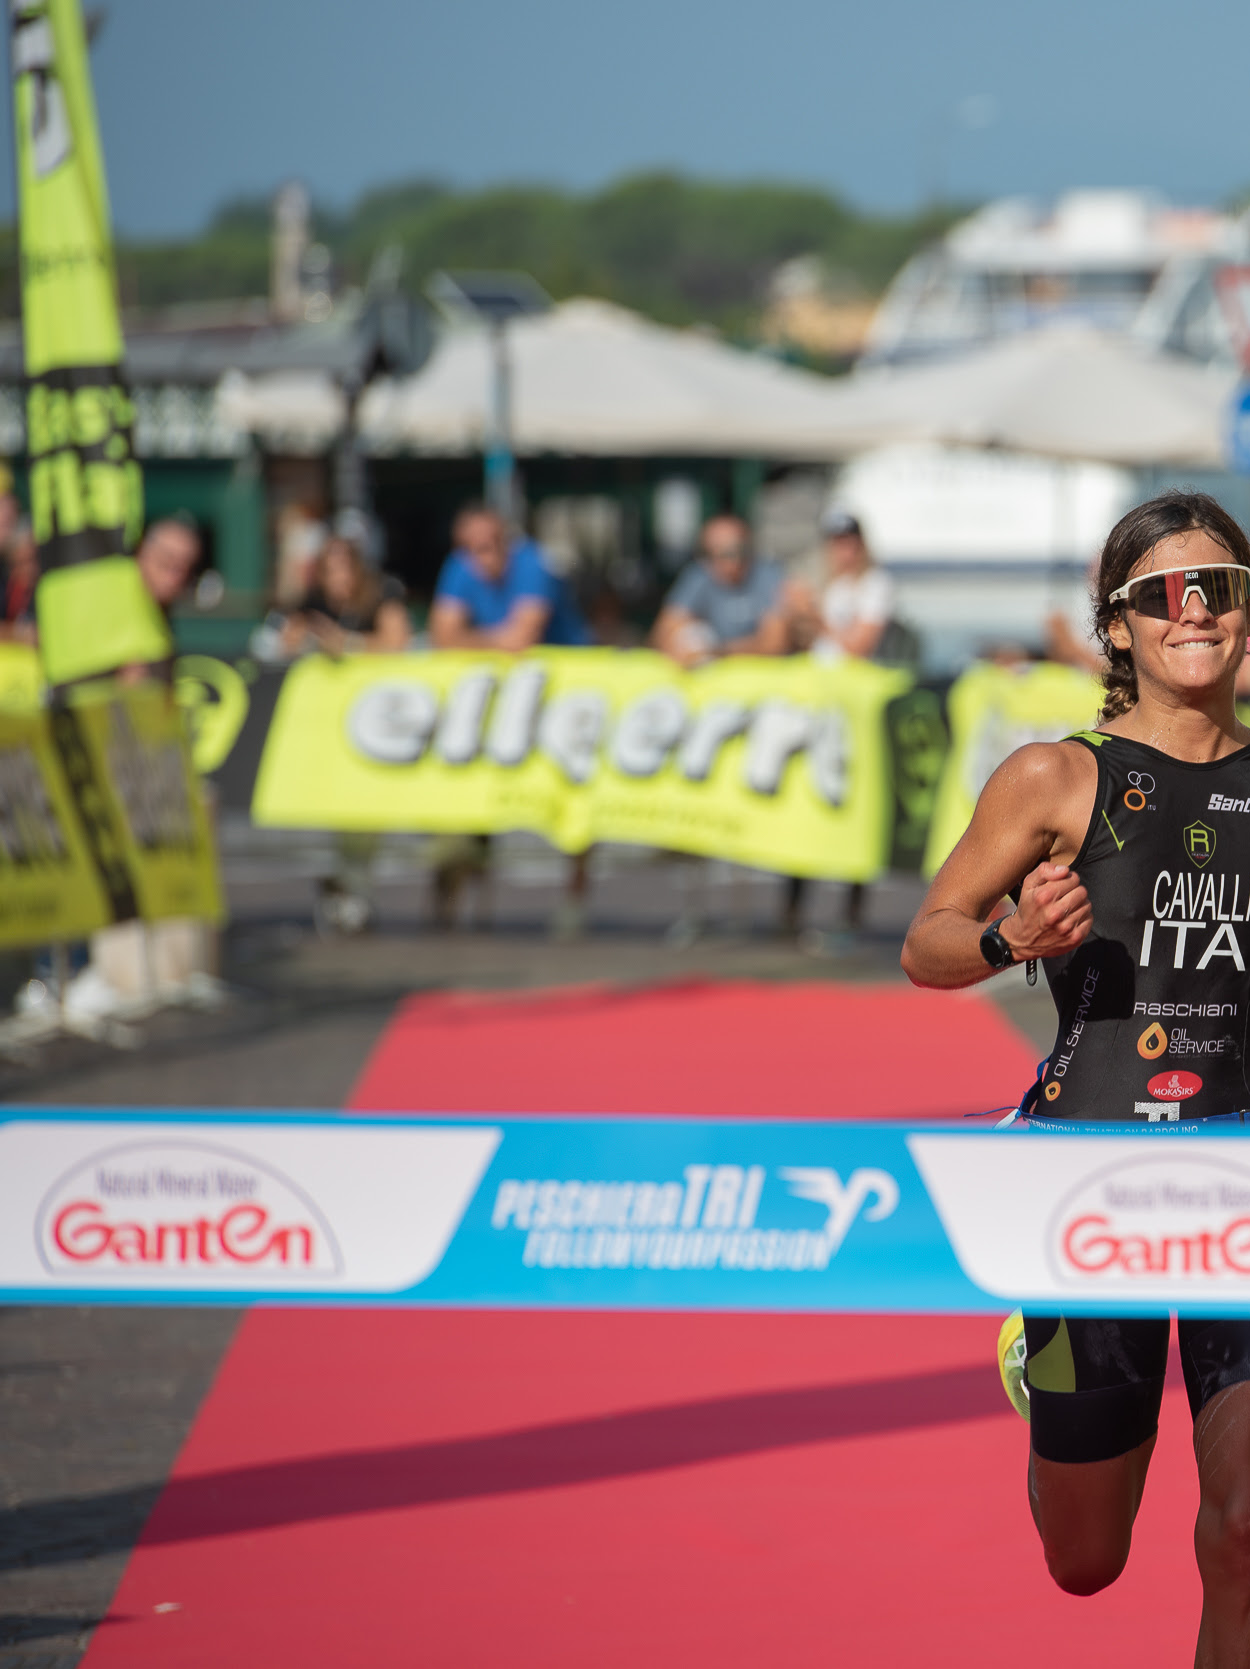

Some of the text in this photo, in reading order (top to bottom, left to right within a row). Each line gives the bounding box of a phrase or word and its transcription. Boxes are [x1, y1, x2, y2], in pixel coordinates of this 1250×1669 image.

[1190, 829, 1210, 852] R
[1139, 920, 1246, 972] ITA
[1053, 966, 1100, 1077] OIL SERVICE
[1170, 1028, 1191, 1041] OIL
[1168, 1040, 1225, 1054] SERVICE
